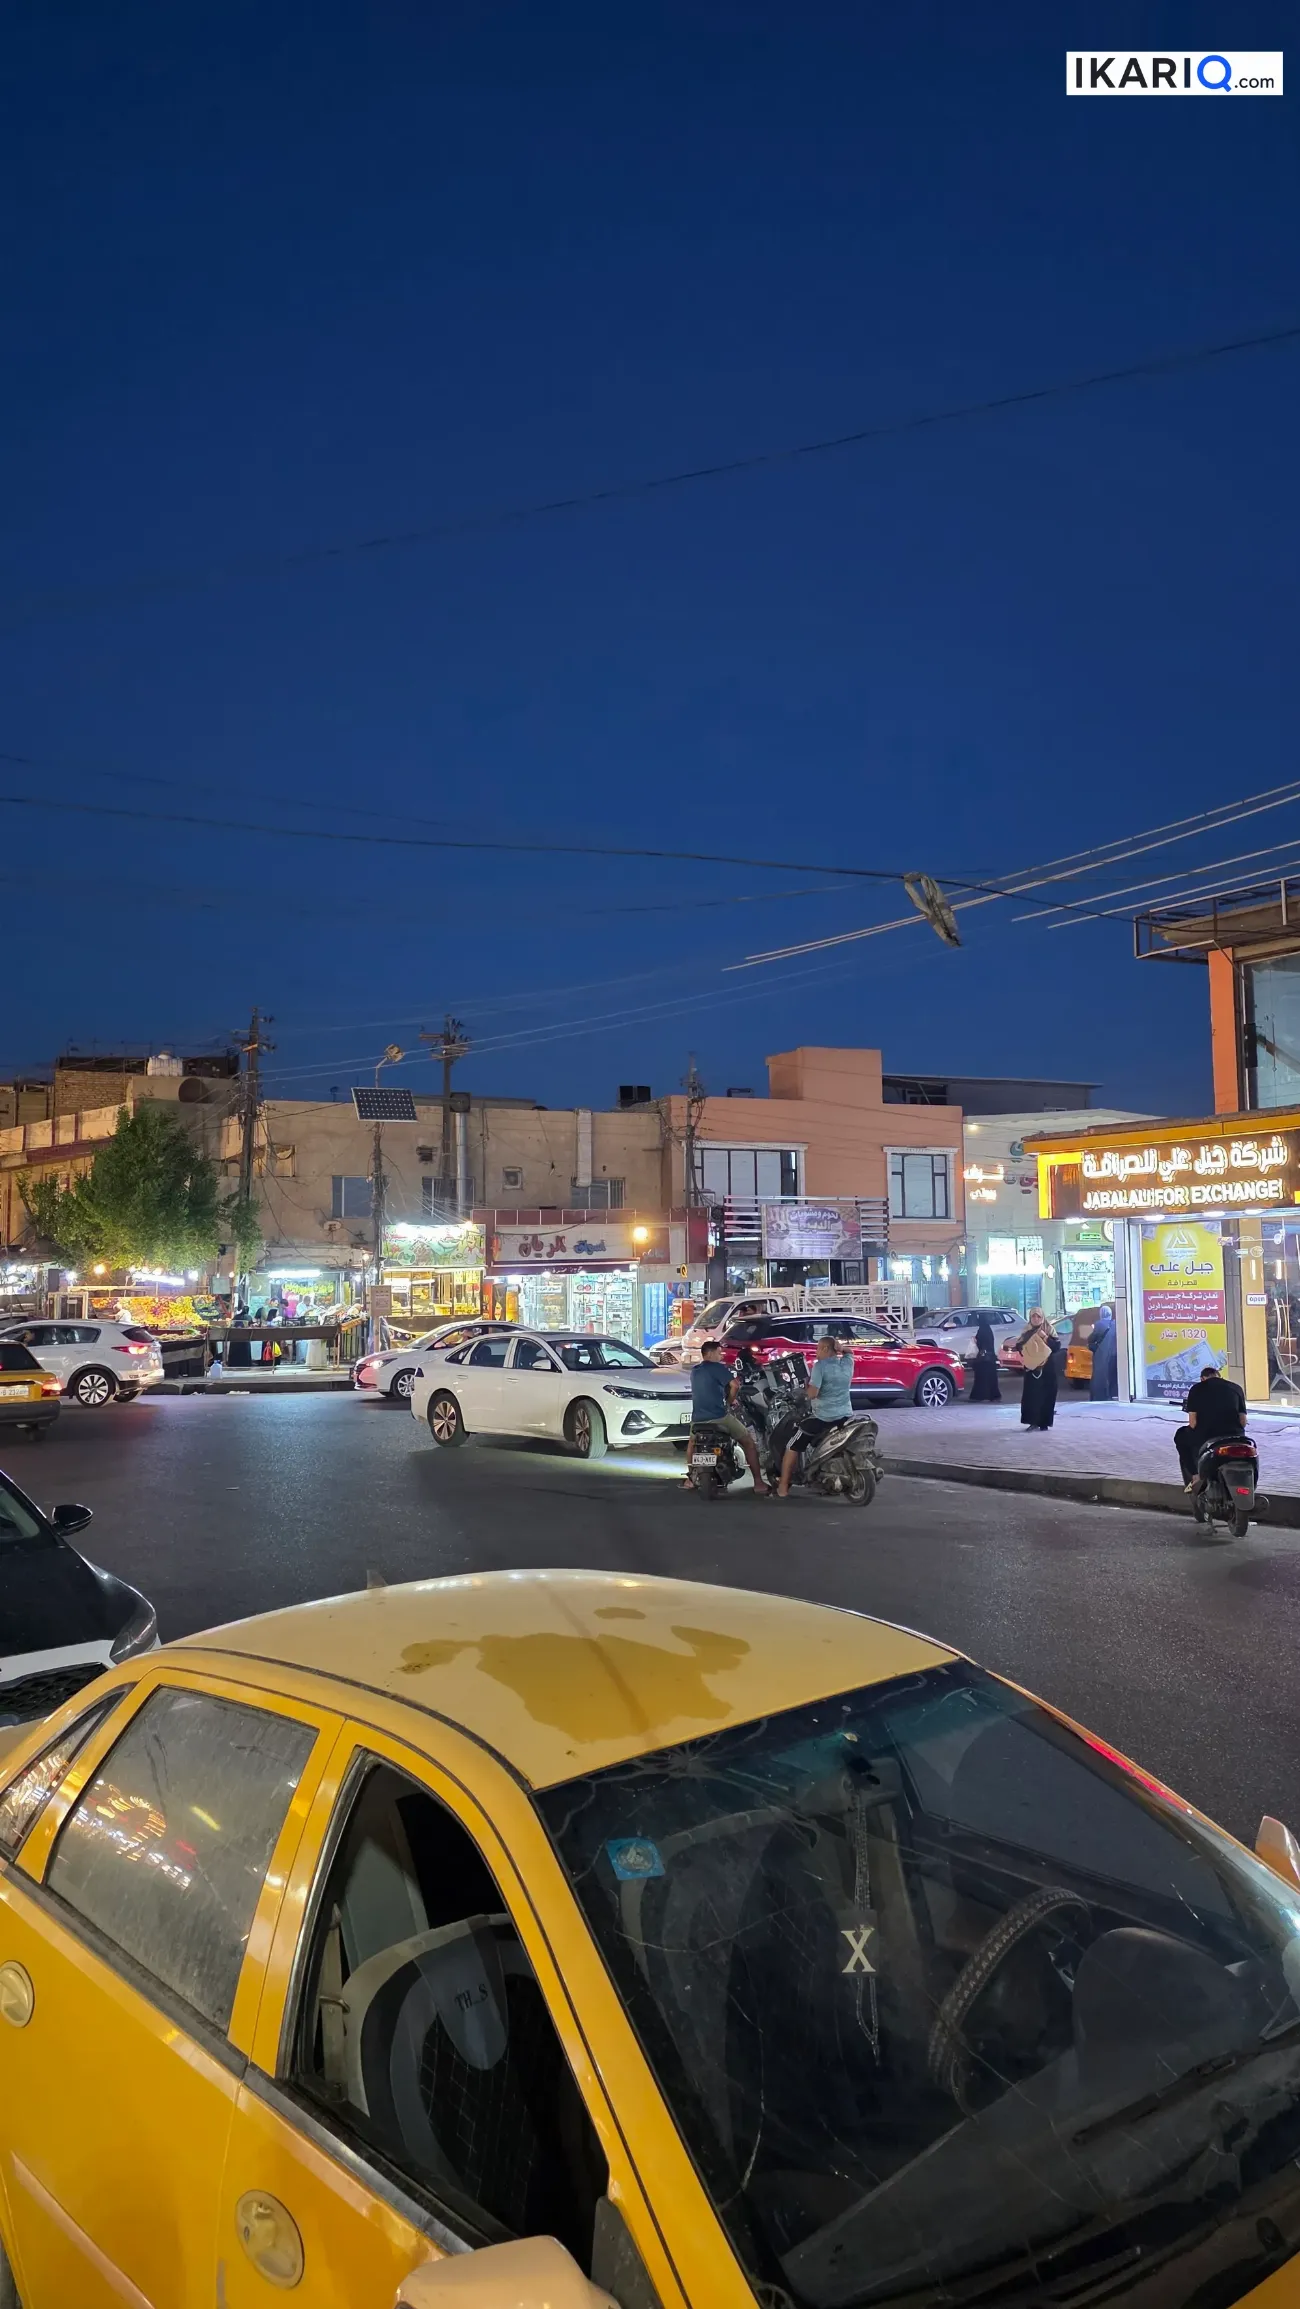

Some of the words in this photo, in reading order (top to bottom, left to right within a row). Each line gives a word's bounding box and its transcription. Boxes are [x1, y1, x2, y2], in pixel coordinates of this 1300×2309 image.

[1158, 1147, 1193, 1184] علي
[1194, 1145, 1229, 1175] جبل
[1231, 1136, 1288, 1174] شركة
[1155, 1185, 1190, 1206] FOR
[1190, 1178, 1284, 1204] EXCHANGE
[1150, 1261, 1180, 1275] علي
[1185, 1261, 1214, 1275] جبل
[1181, 1329, 1207, 1339] 1320
[840, 1926, 877, 1973] X
